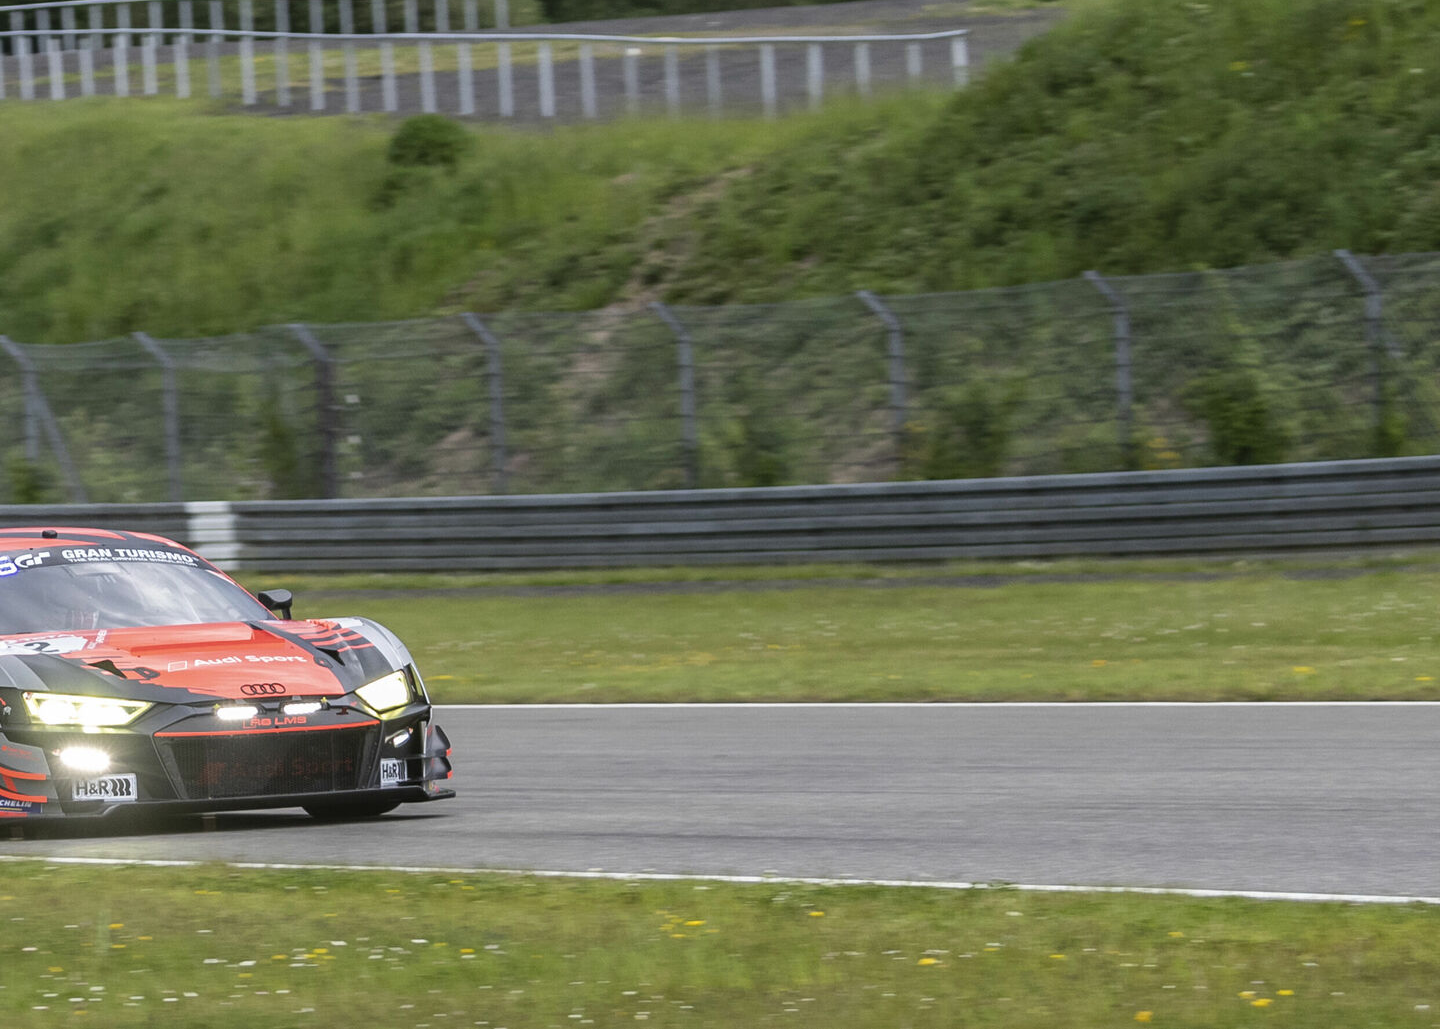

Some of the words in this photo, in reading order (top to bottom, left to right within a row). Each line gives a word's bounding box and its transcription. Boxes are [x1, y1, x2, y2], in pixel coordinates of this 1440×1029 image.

[61, 548, 112, 560] GRAN
[114, 548, 194, 563] TURISMO
[194, 655, 242, 667] Audi
[244, 655, 307, 663] Sport
[274, 716, 307, 725] LMS
[76, 777, 110, 796] H&R
